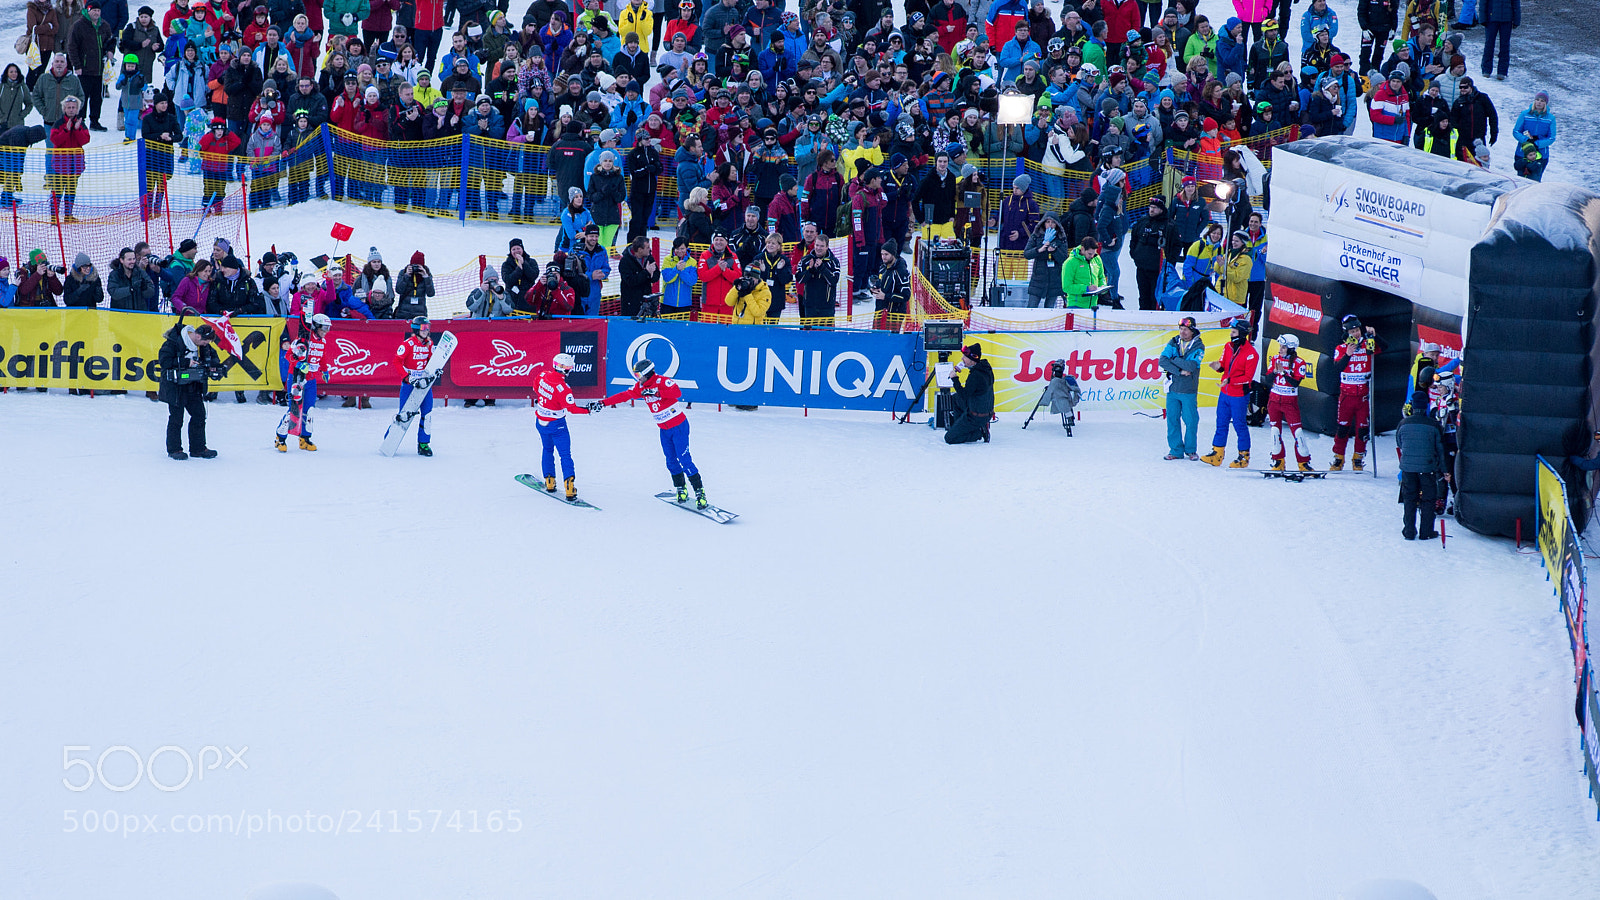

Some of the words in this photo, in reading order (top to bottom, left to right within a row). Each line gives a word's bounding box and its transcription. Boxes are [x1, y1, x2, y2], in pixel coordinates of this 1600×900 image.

[1355, 187, 1426, 217] SNOWBOARD
[1355, 201, 1388, 219] WORLD
[1388, 210, 1405, 224] CUP
[1343, 240, 1386, 262] Lackenhof
[1387, 255, 1401, 266] am
[1339, 251, 1400, 283] ÖTSCHER
[1293, 302, 1322, 322] Zeitung
[565, 345, 594, 354] WURST
[326, 361, 389, 376] moser
[469, 361, 544, 376] moser
[717, 346, 916, 400] UNIQA
[1104, 387, 1115, 401] &
[1118, 386, 1160, 401] molke
